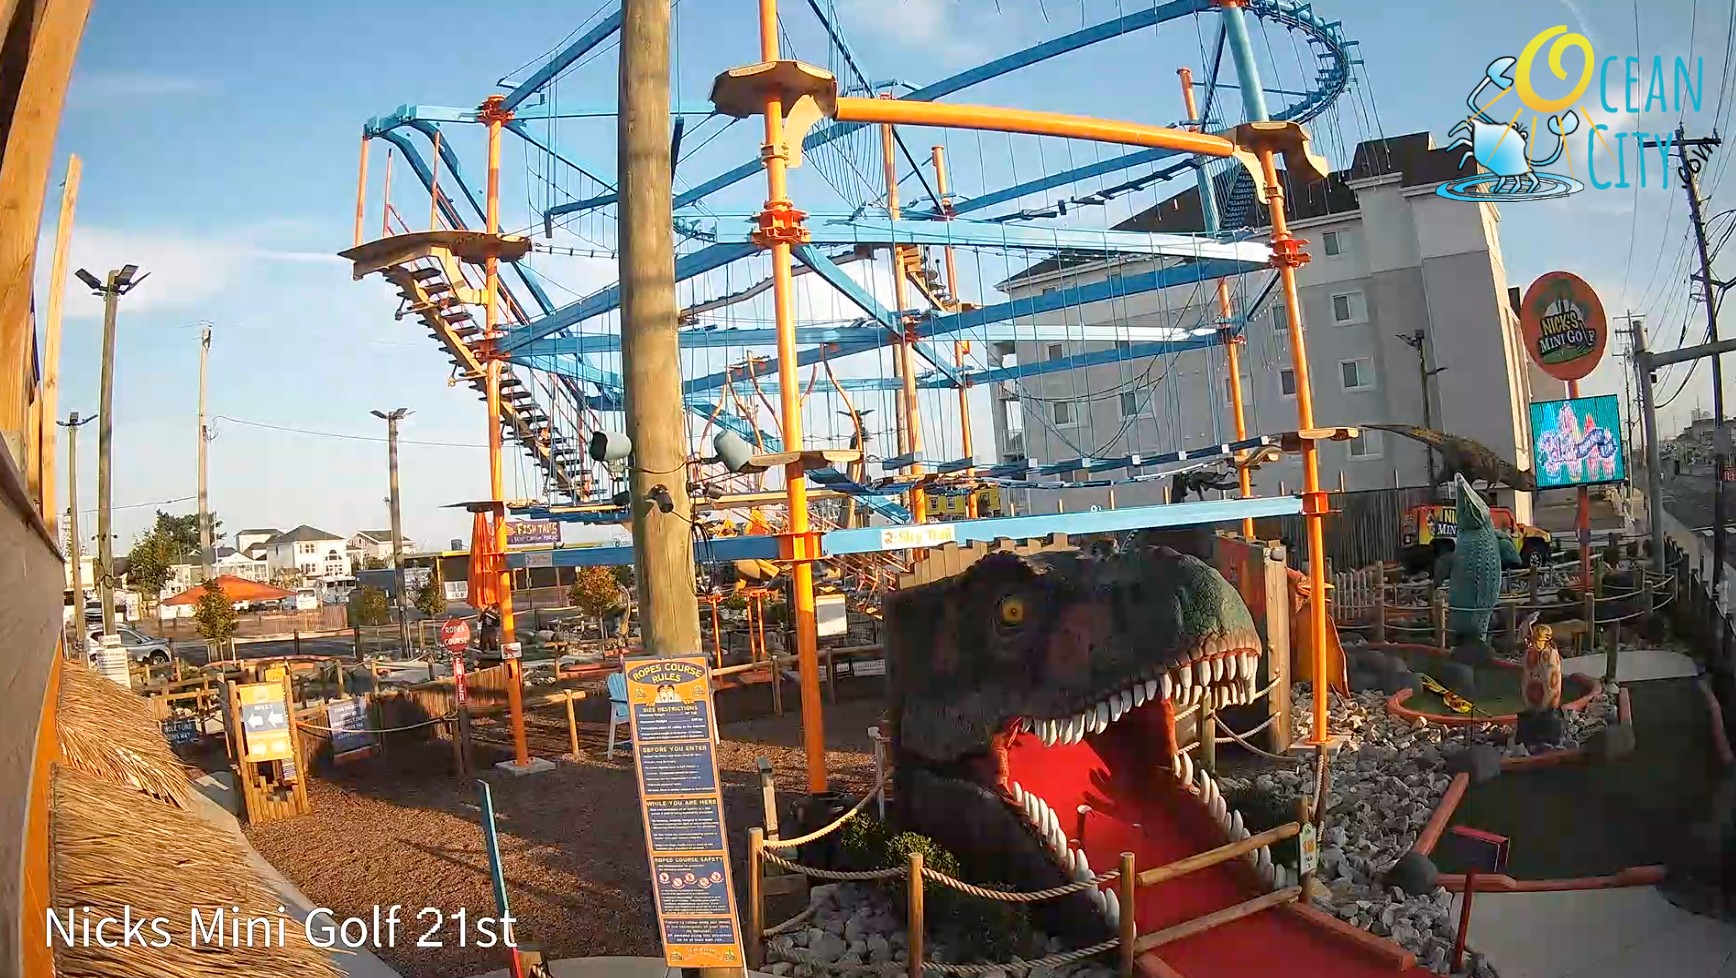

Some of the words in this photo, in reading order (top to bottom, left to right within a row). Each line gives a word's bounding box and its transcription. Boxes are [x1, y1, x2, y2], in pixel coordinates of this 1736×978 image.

[1541, 311, 1578, 336] NICK'S
[1539, 333, 1565, 353] MINI
[1567, 323, 1596, 346] GOLF
[517, 522, 537, 535] FISH
[1437, 523, 1458, 535] MIN
[633, 664, 661, 681] ROPES
[664, 663, 702, 678] COURSE
[651, 673, 682, 684] RULES
